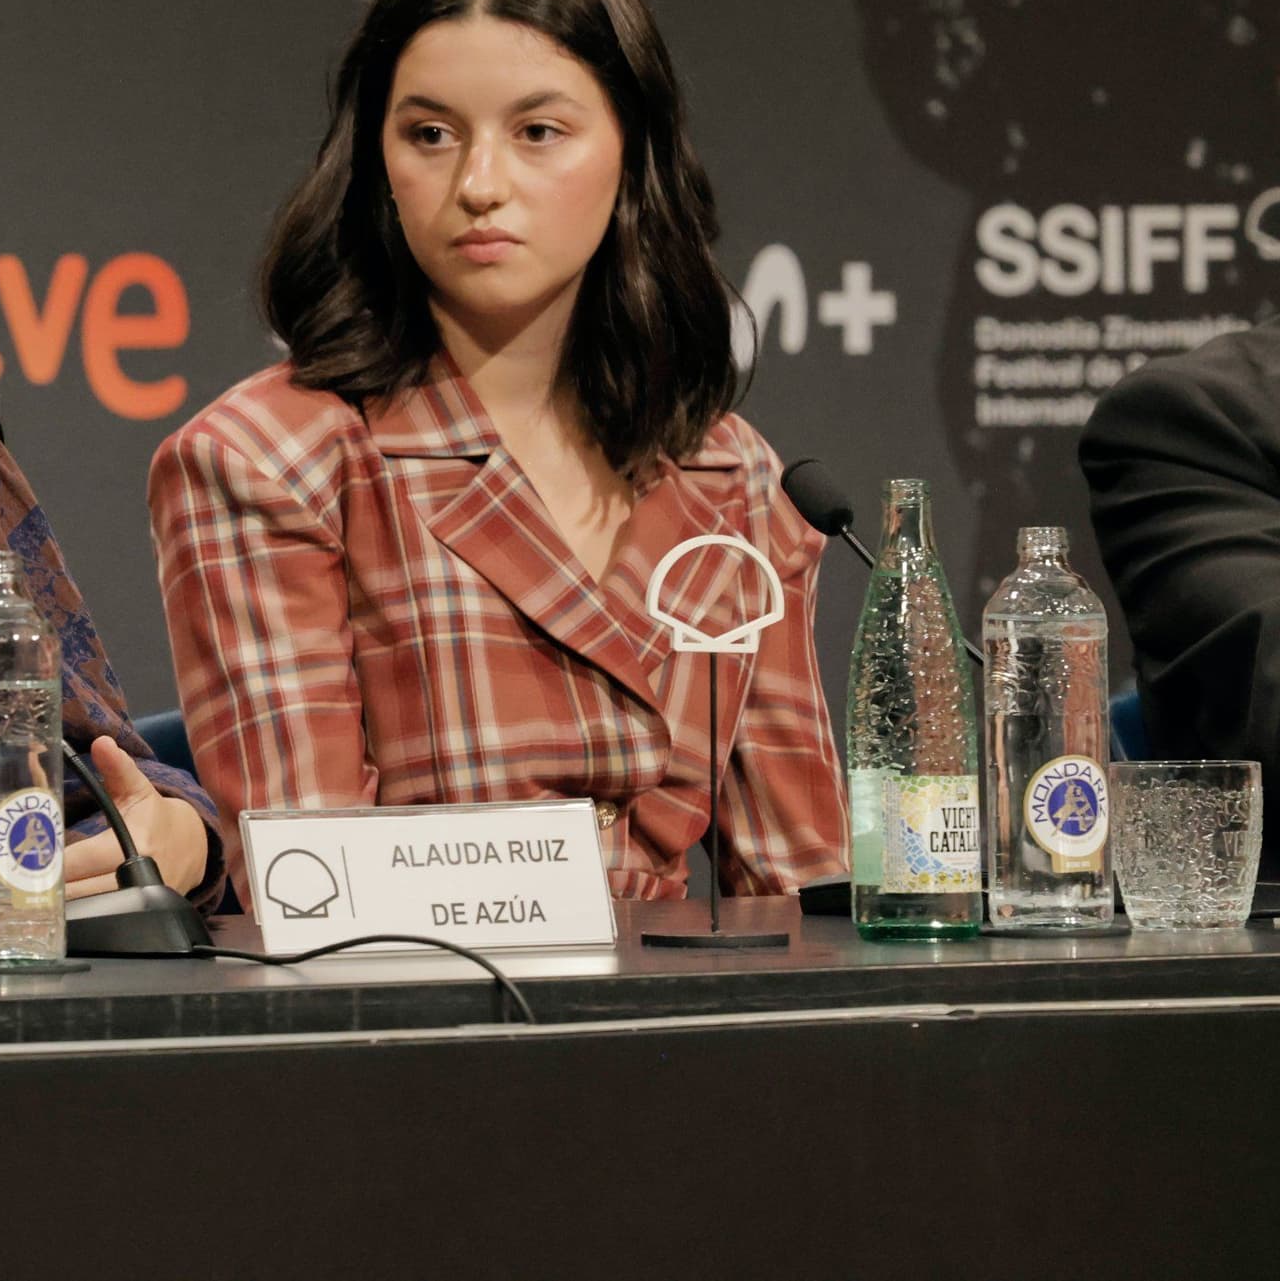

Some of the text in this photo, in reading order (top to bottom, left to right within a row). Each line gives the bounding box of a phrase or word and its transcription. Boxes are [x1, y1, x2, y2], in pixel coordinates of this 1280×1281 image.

[976, 203, 1240, 297] SSIFF
[391, 839, 569, 868] ALAUDA RUIZ
[430, 894, 547, 927] DE AZÚA
